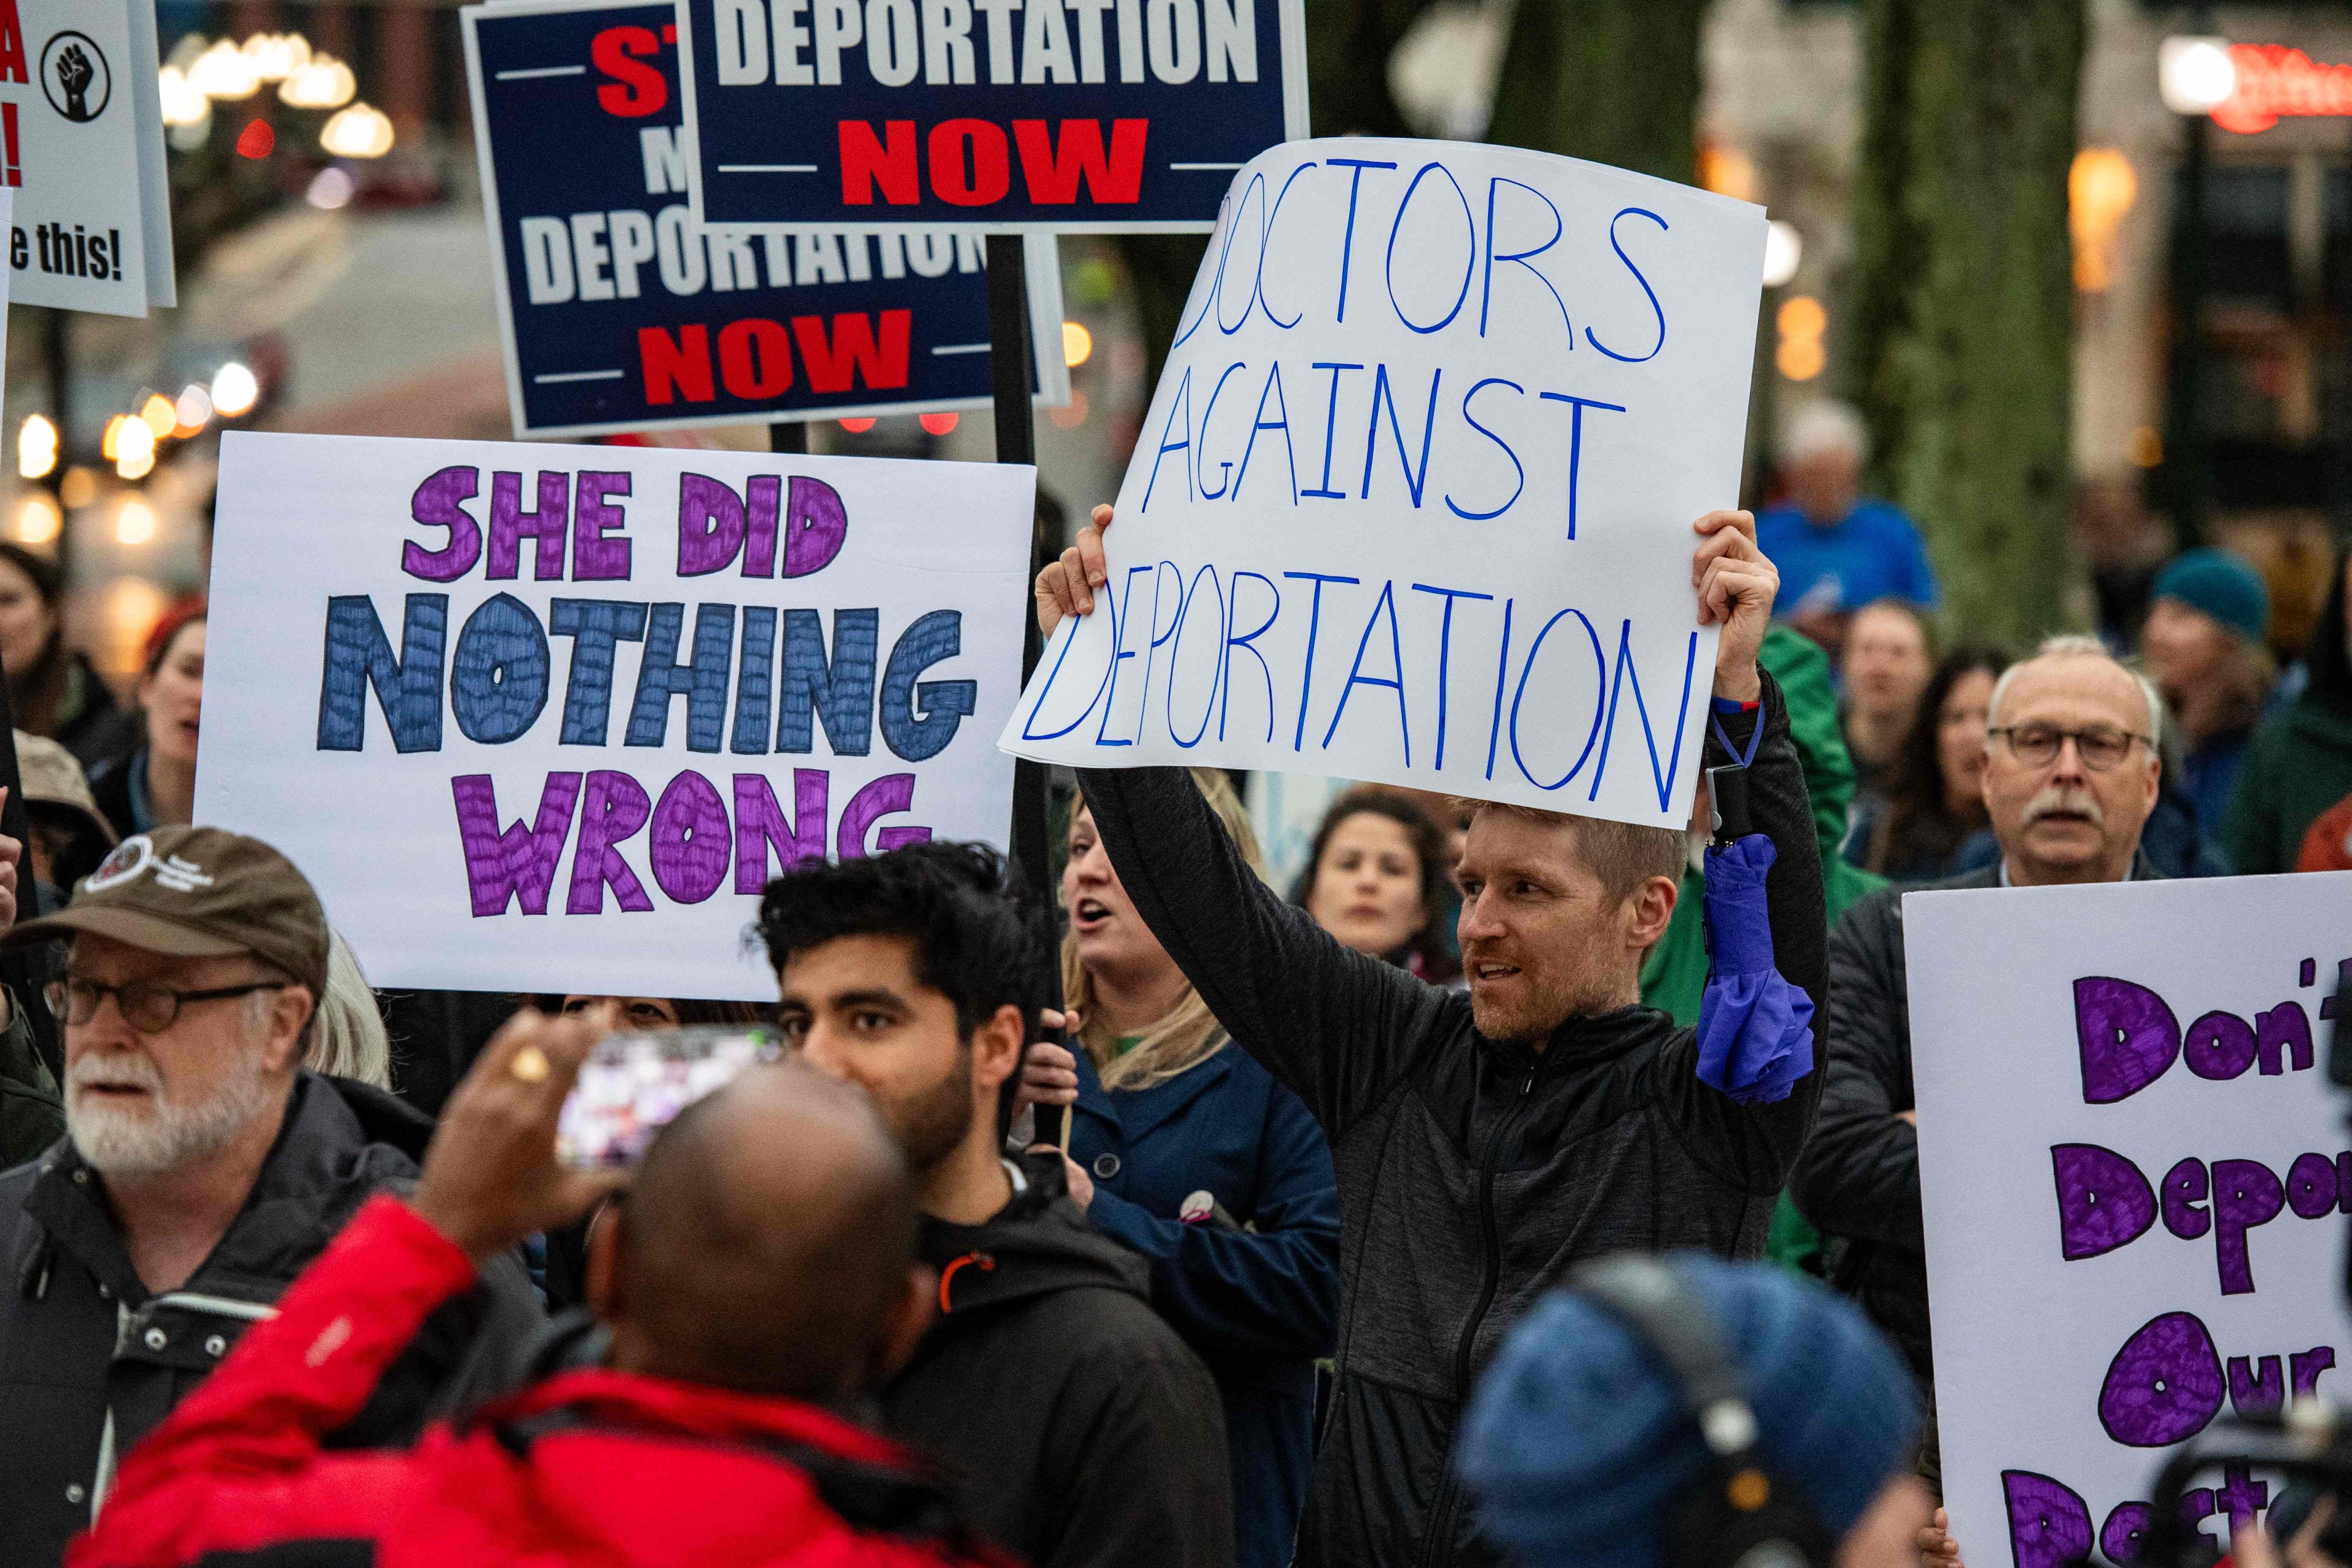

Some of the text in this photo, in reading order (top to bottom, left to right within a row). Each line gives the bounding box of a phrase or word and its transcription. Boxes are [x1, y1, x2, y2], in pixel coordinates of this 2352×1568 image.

[591, 23, 678, 118] S
[714, 0, 1259, 87] DEPORTATION
[838, 118, 1149, 207] NOW
[37, 223, 122, 281] this!
[1173, 159, 1669, 362] DOCTORS
[639, 309, 912, 405] NOW
[1142, 361, 1627, 540] AGAINST
[401, 465, 848, 583] SHE DID
[316, 592, 978, 763] NOTHING
[1022, 561, 1698, 813] DEPORTATION
[450, 768, 933, 918] WRONG
[2098, 1311, 2336, 1448] Our
